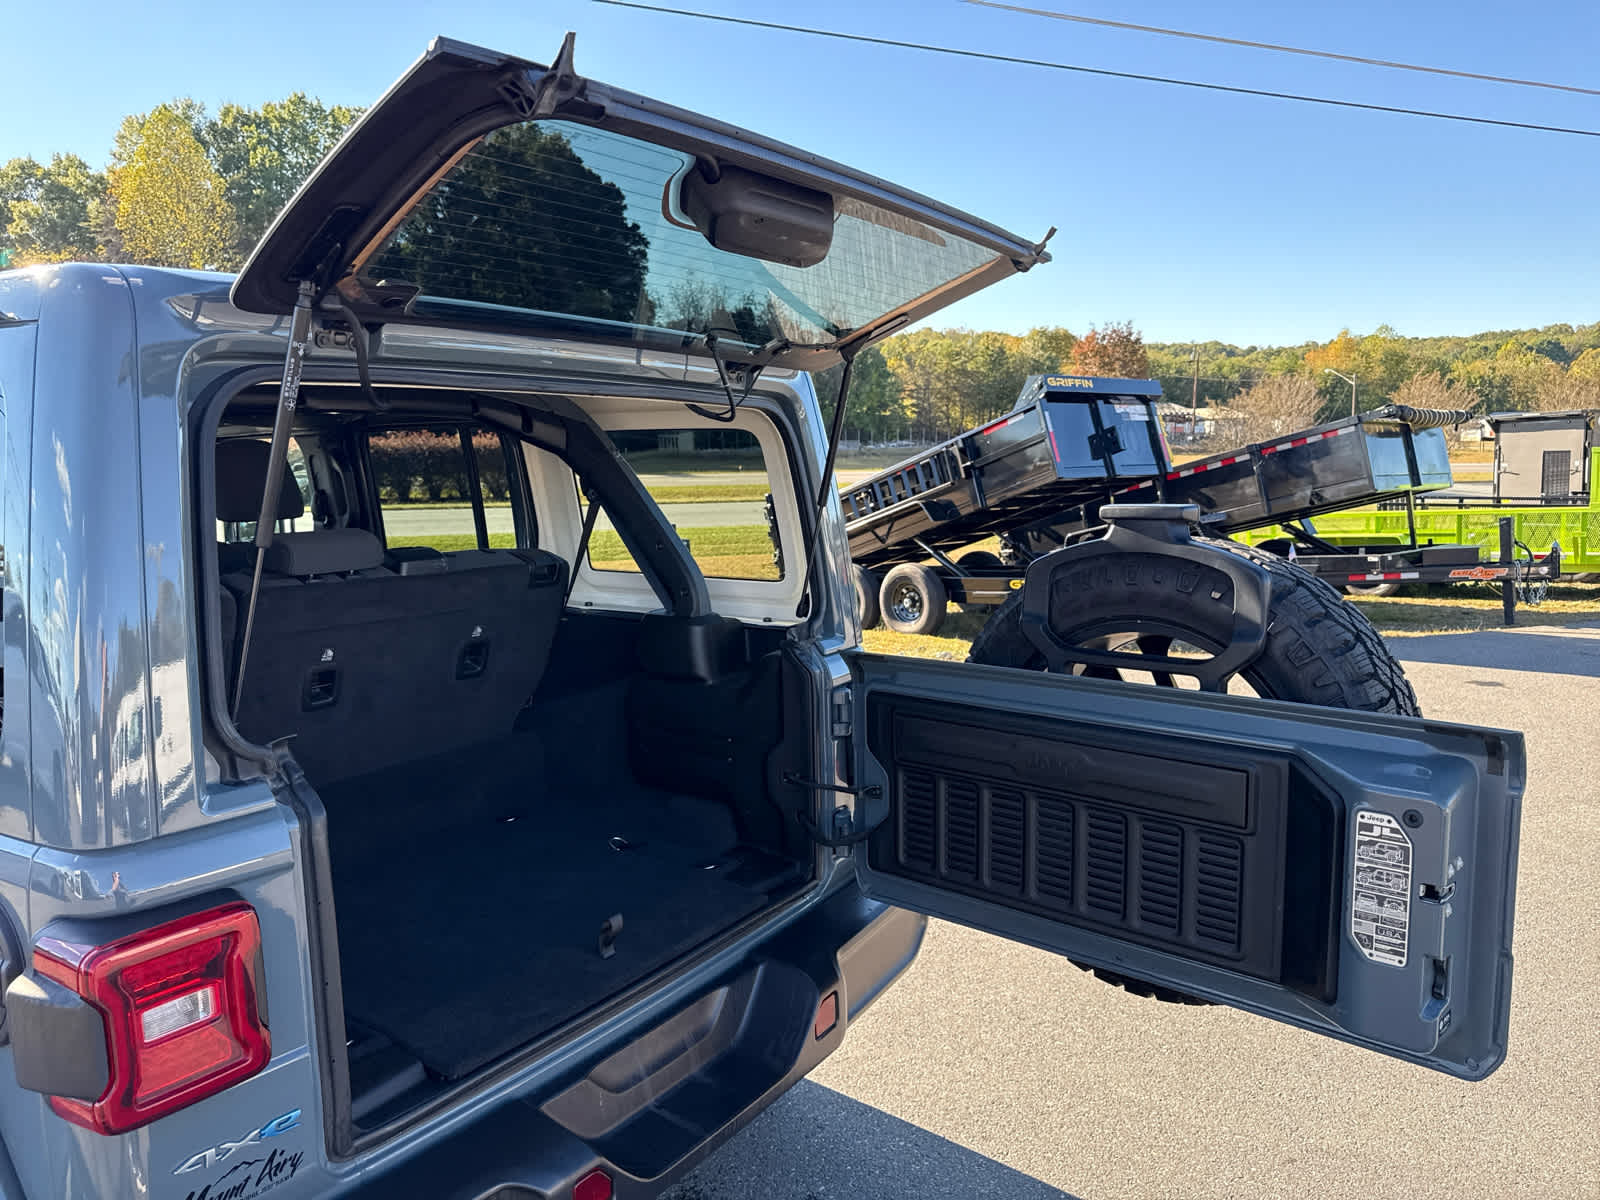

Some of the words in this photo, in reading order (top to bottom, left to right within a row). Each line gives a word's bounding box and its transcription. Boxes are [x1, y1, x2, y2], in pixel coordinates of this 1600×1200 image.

[1047, 377, 1094, 389] GRIFFIN
[184, 1174, 252, 1200] Munt
[255, 1148, 304, 1188] Airy
